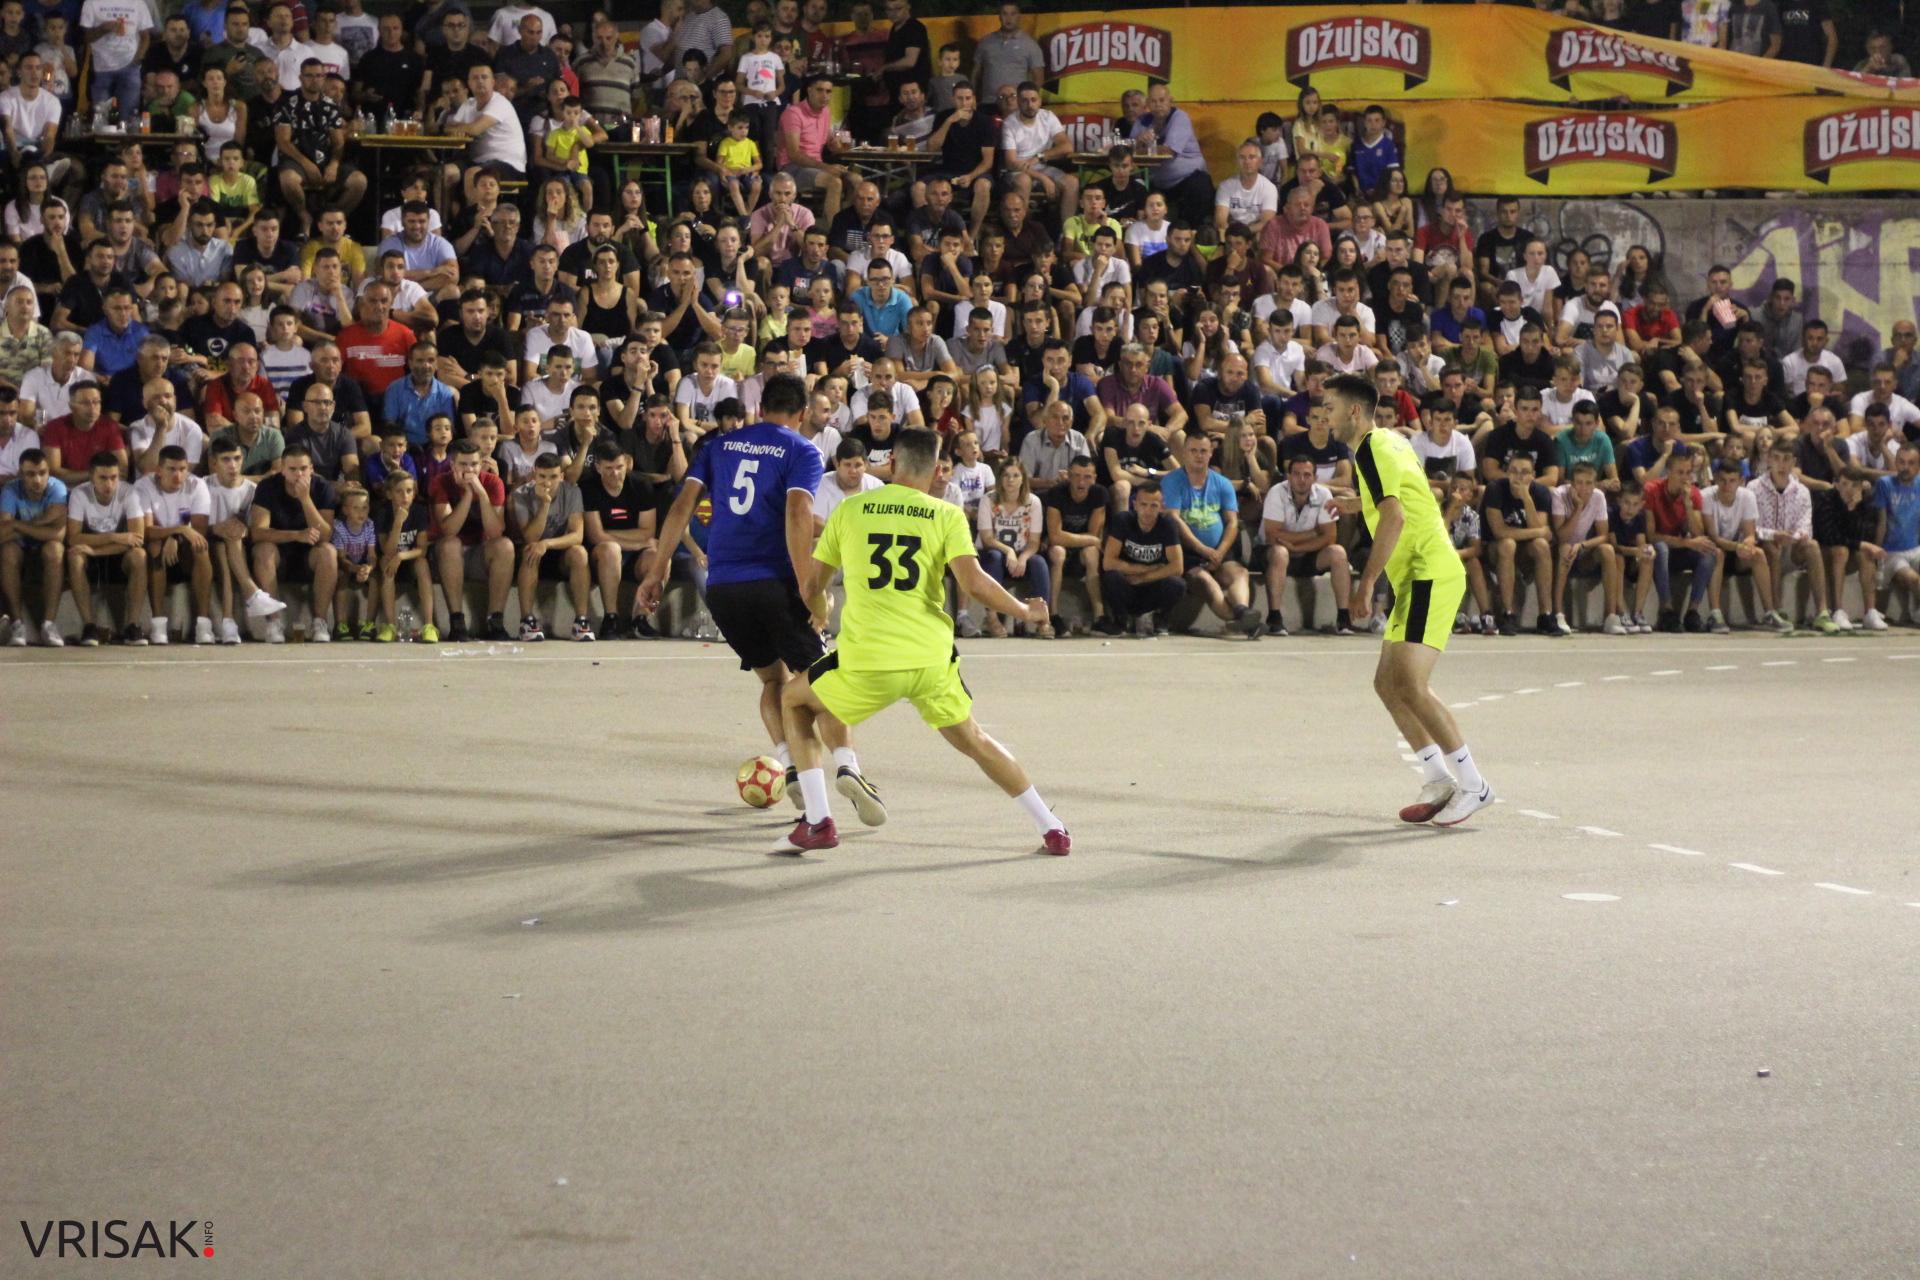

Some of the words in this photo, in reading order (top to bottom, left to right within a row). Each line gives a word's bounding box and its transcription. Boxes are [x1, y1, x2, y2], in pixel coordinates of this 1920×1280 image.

[1050, 24, 1161, 72] Ožujsko
[1298, 19, 1418, 67] Ožujsko
[1538, 115, 1665, 161] Ožujsko
[723, 441, 786, 458] TURČINOVIĆI
[729, 459, 760, 515] 5
[862, 503, 876, 514] MZ
[876, 503, 905, 515] LIJEVA
[906, 505, 935, 520] OBALA
[868, 533, 922, 591] 33
